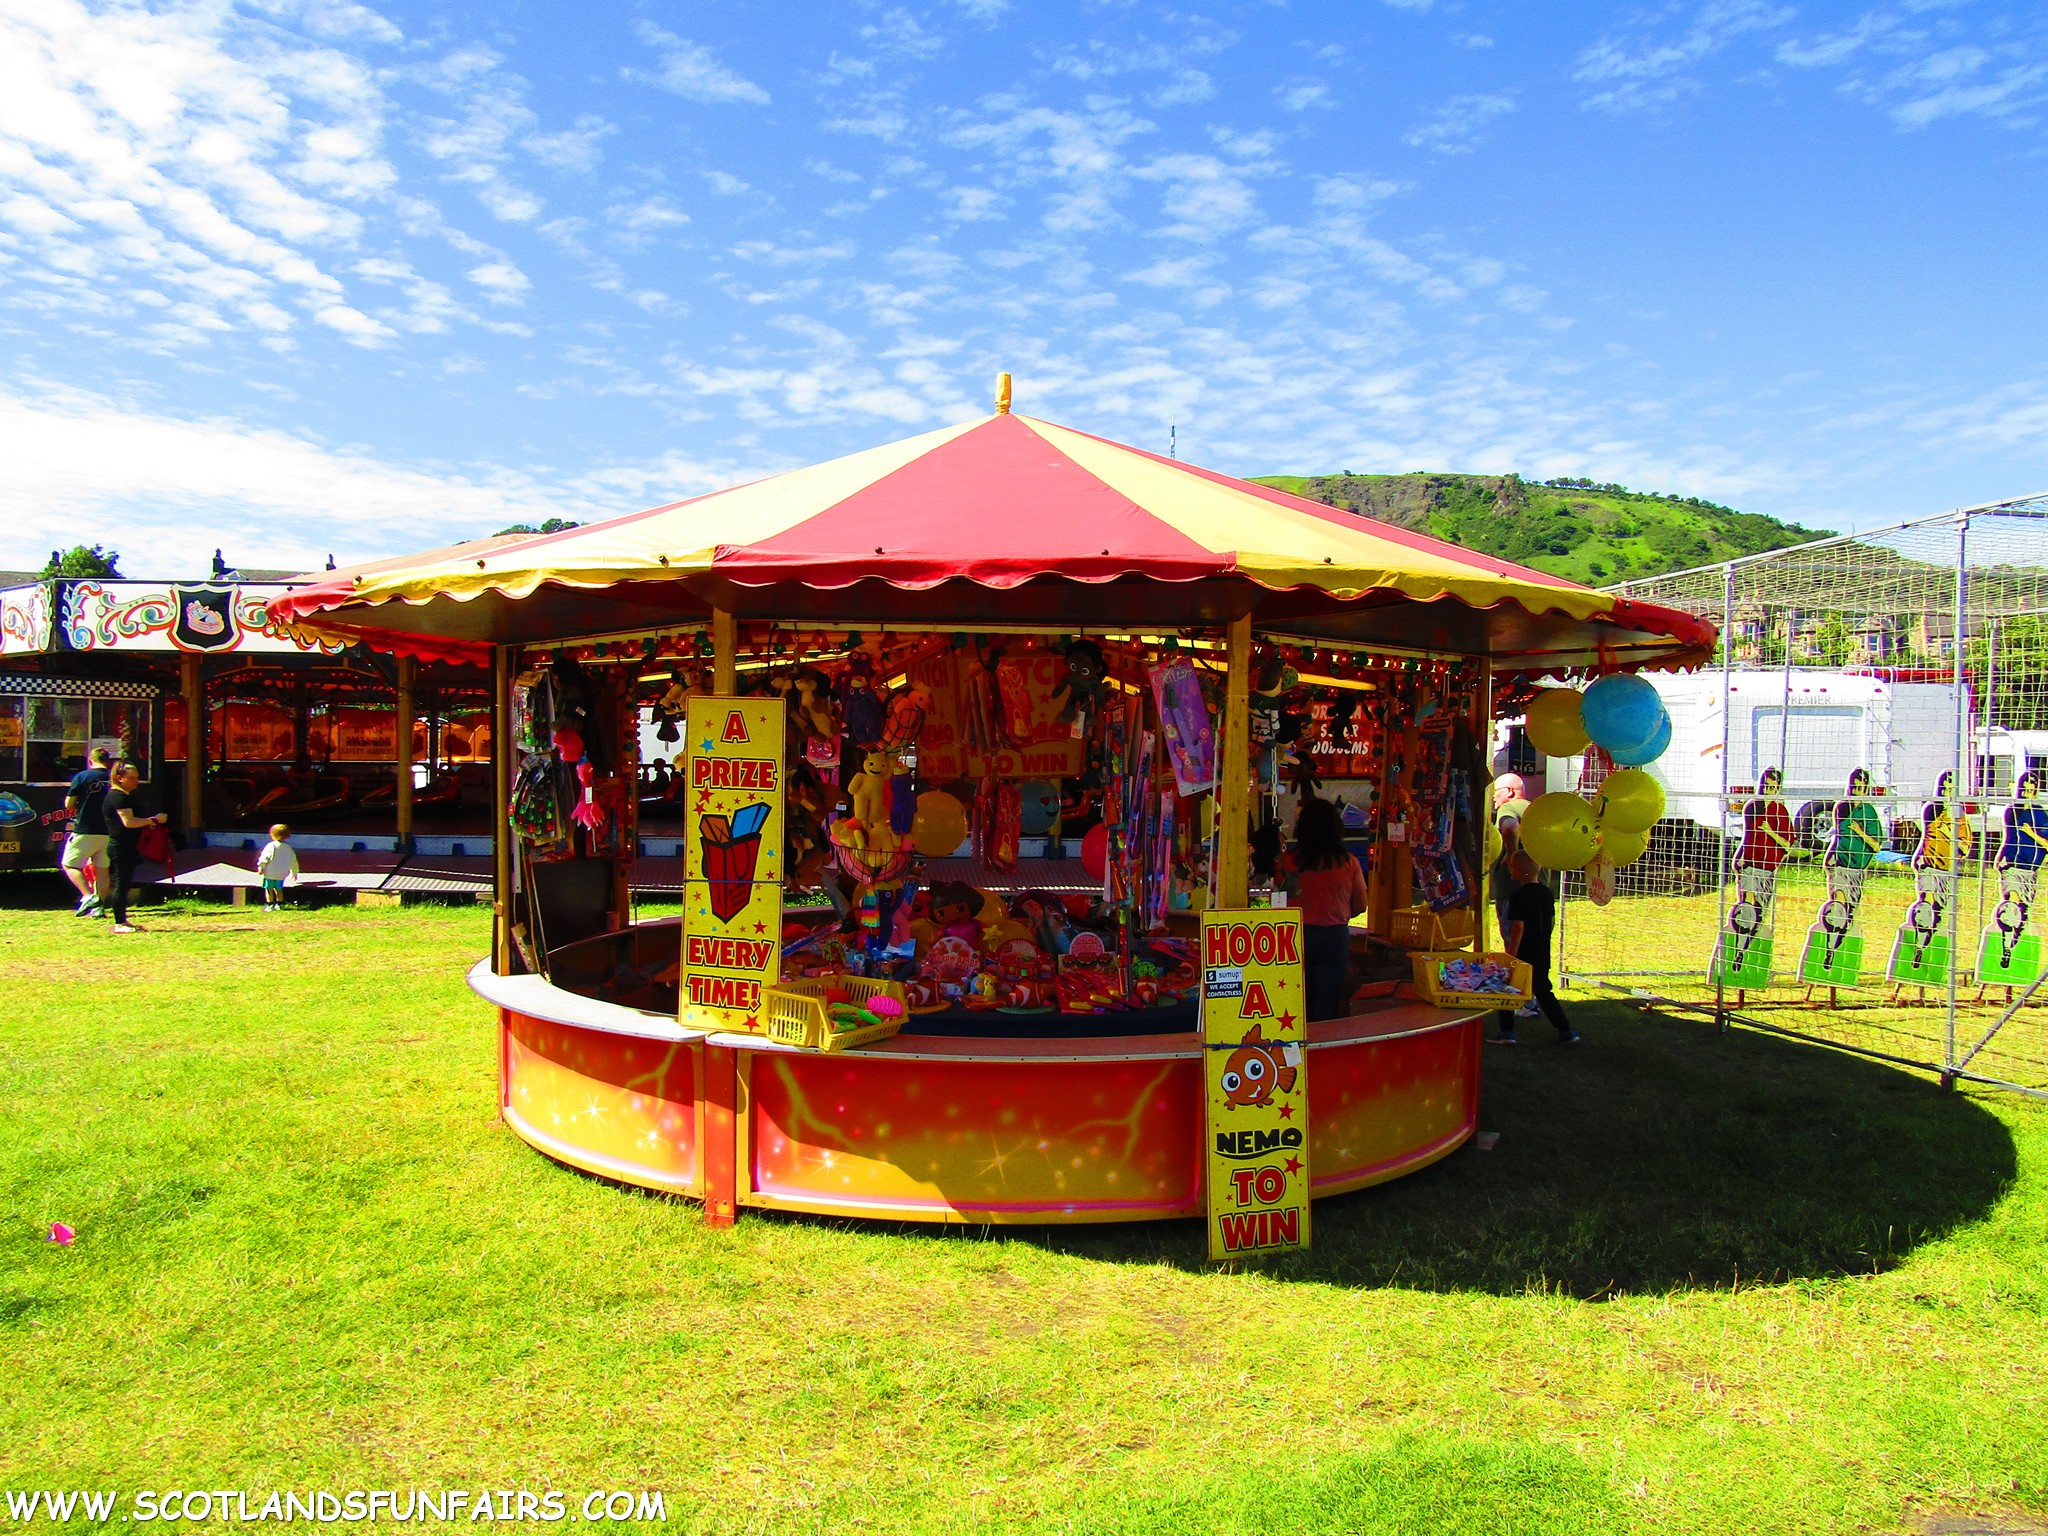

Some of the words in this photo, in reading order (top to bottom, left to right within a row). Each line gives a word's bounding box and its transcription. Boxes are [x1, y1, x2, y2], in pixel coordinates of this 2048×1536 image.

[721, 710, 750, 744] A
[692, 757, 778, 791] PRIZE
[1021, 753, 1068, 773] WIN
[686, 935, 775, 972] EVERY
[1205, 921, 1299, 968] HOOK
[686, 974, 763, 1012] TIME!
[1239, 981, 1273, 1018] A
[1216, 1128, 1303, 1155] NEMO
[1230, 1166, 1287, 1207] TO
[1220, 1206, 1300, 1252] WIN
